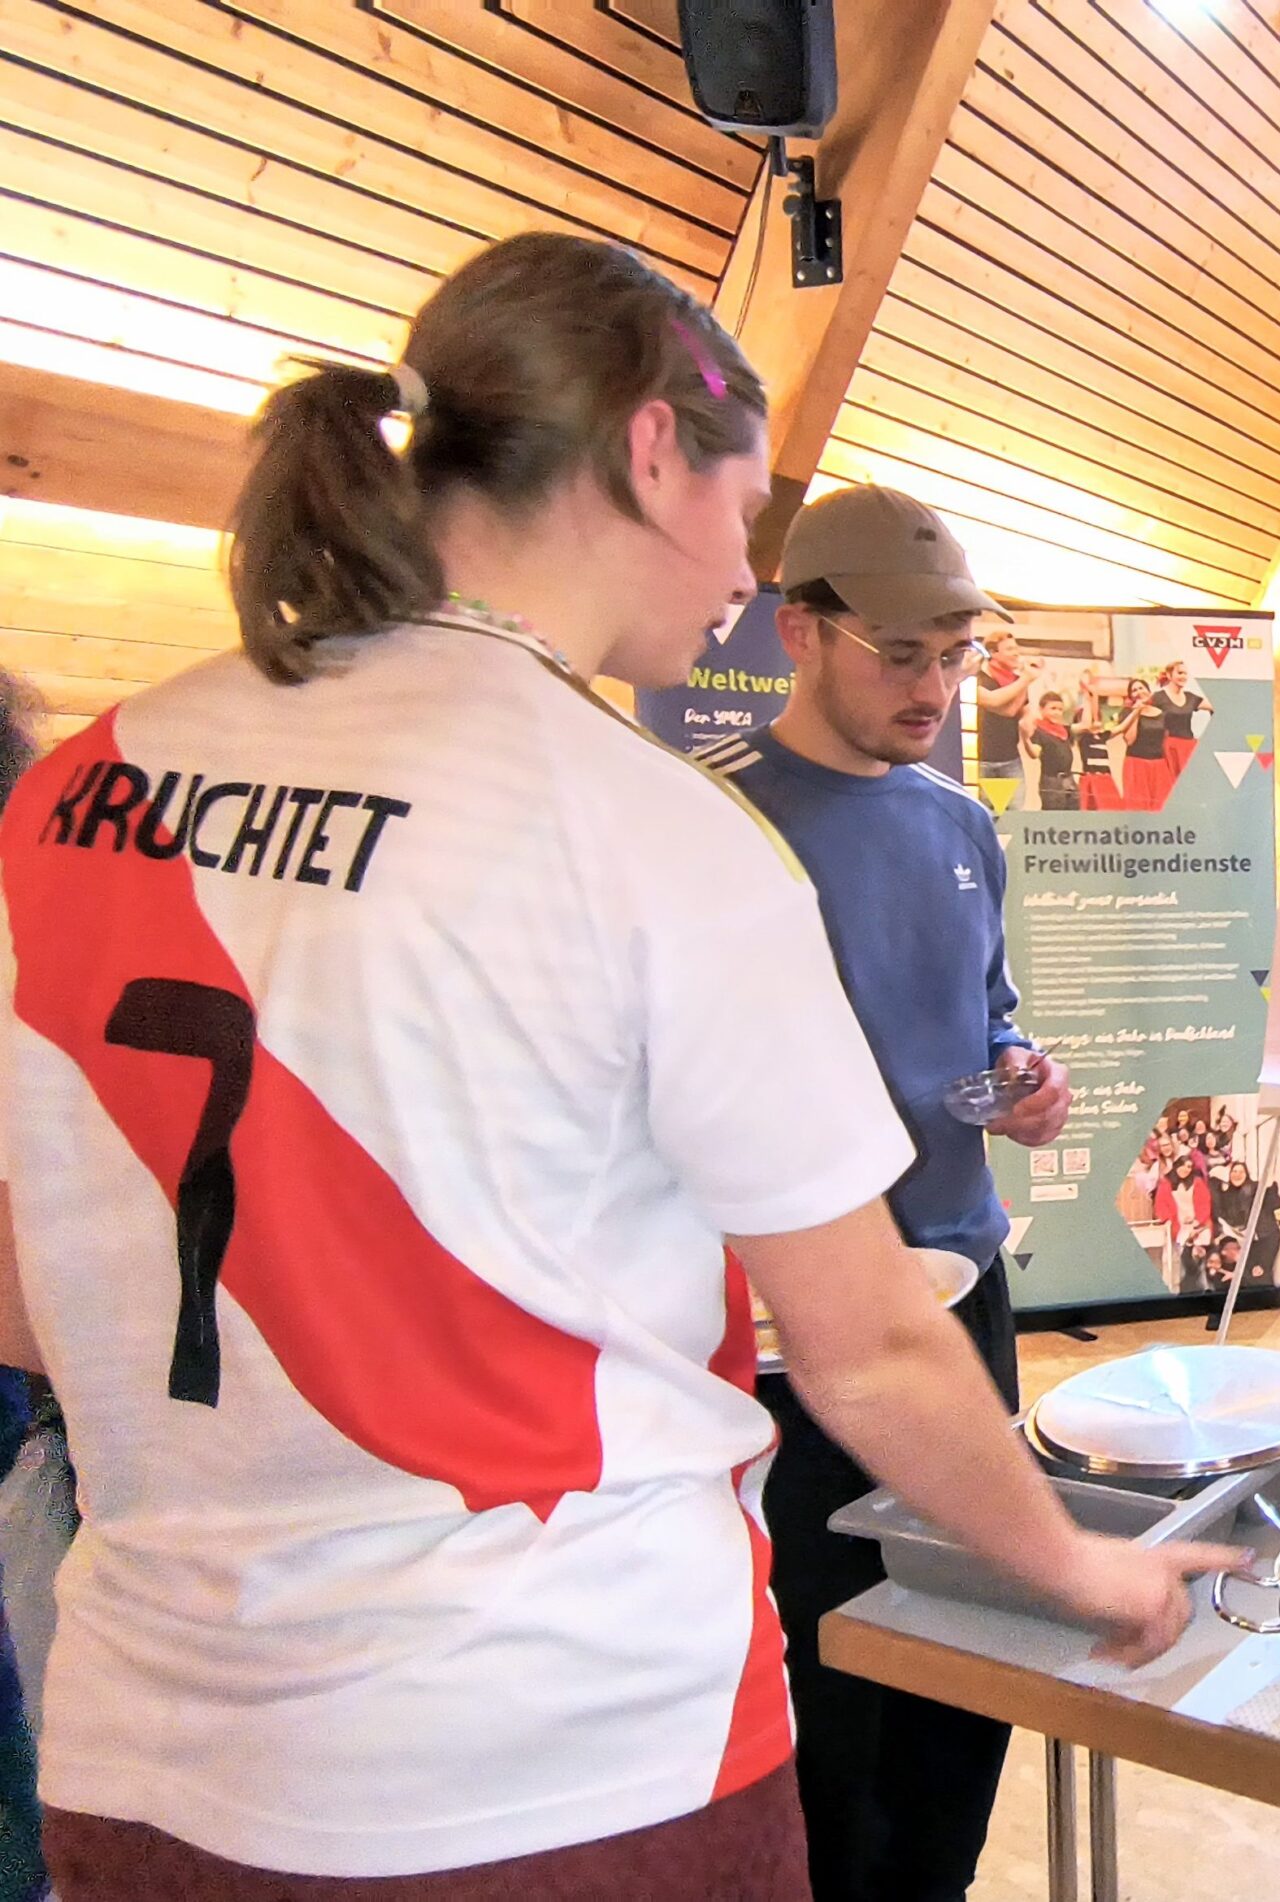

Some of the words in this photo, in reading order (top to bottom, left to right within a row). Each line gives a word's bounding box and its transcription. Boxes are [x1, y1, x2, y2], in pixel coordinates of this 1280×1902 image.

[1194, 637, 1242, 648] CVJM
[38, 760, 412, 893] KRUCHTET
[1024, 826, 1195, 845] Internationale
[1024, 854, 1251, 878] Freiwilligendienste
[104, 977, 256, 1408] 7
